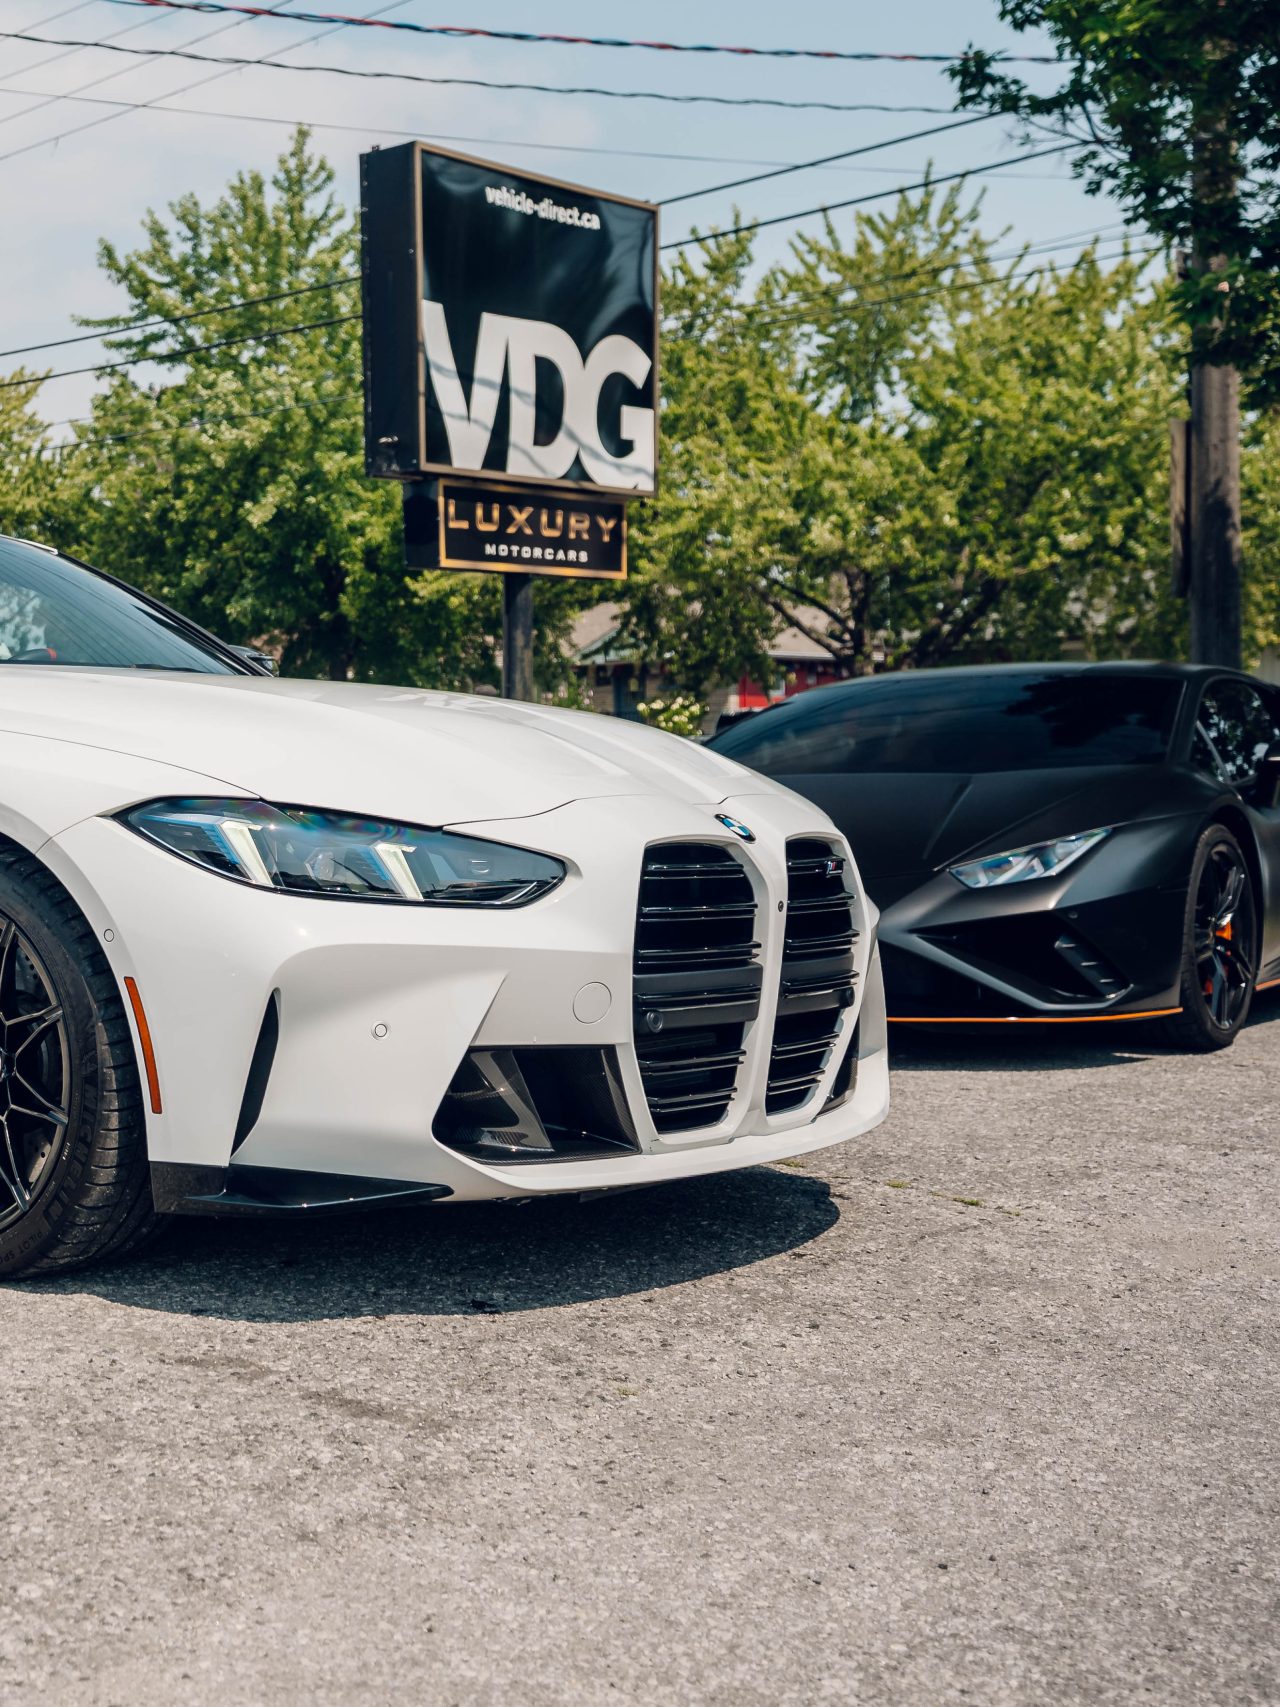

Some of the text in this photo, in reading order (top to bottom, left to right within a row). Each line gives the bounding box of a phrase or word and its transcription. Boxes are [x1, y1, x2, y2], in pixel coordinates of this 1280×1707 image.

[485, 186, 601, 230] vehicle-direct.ca
[422, 299, 655, 490] VDG
[448, 499, 618, 542] LUXURY
[485, 543, 589, 563] MOTORCARS
